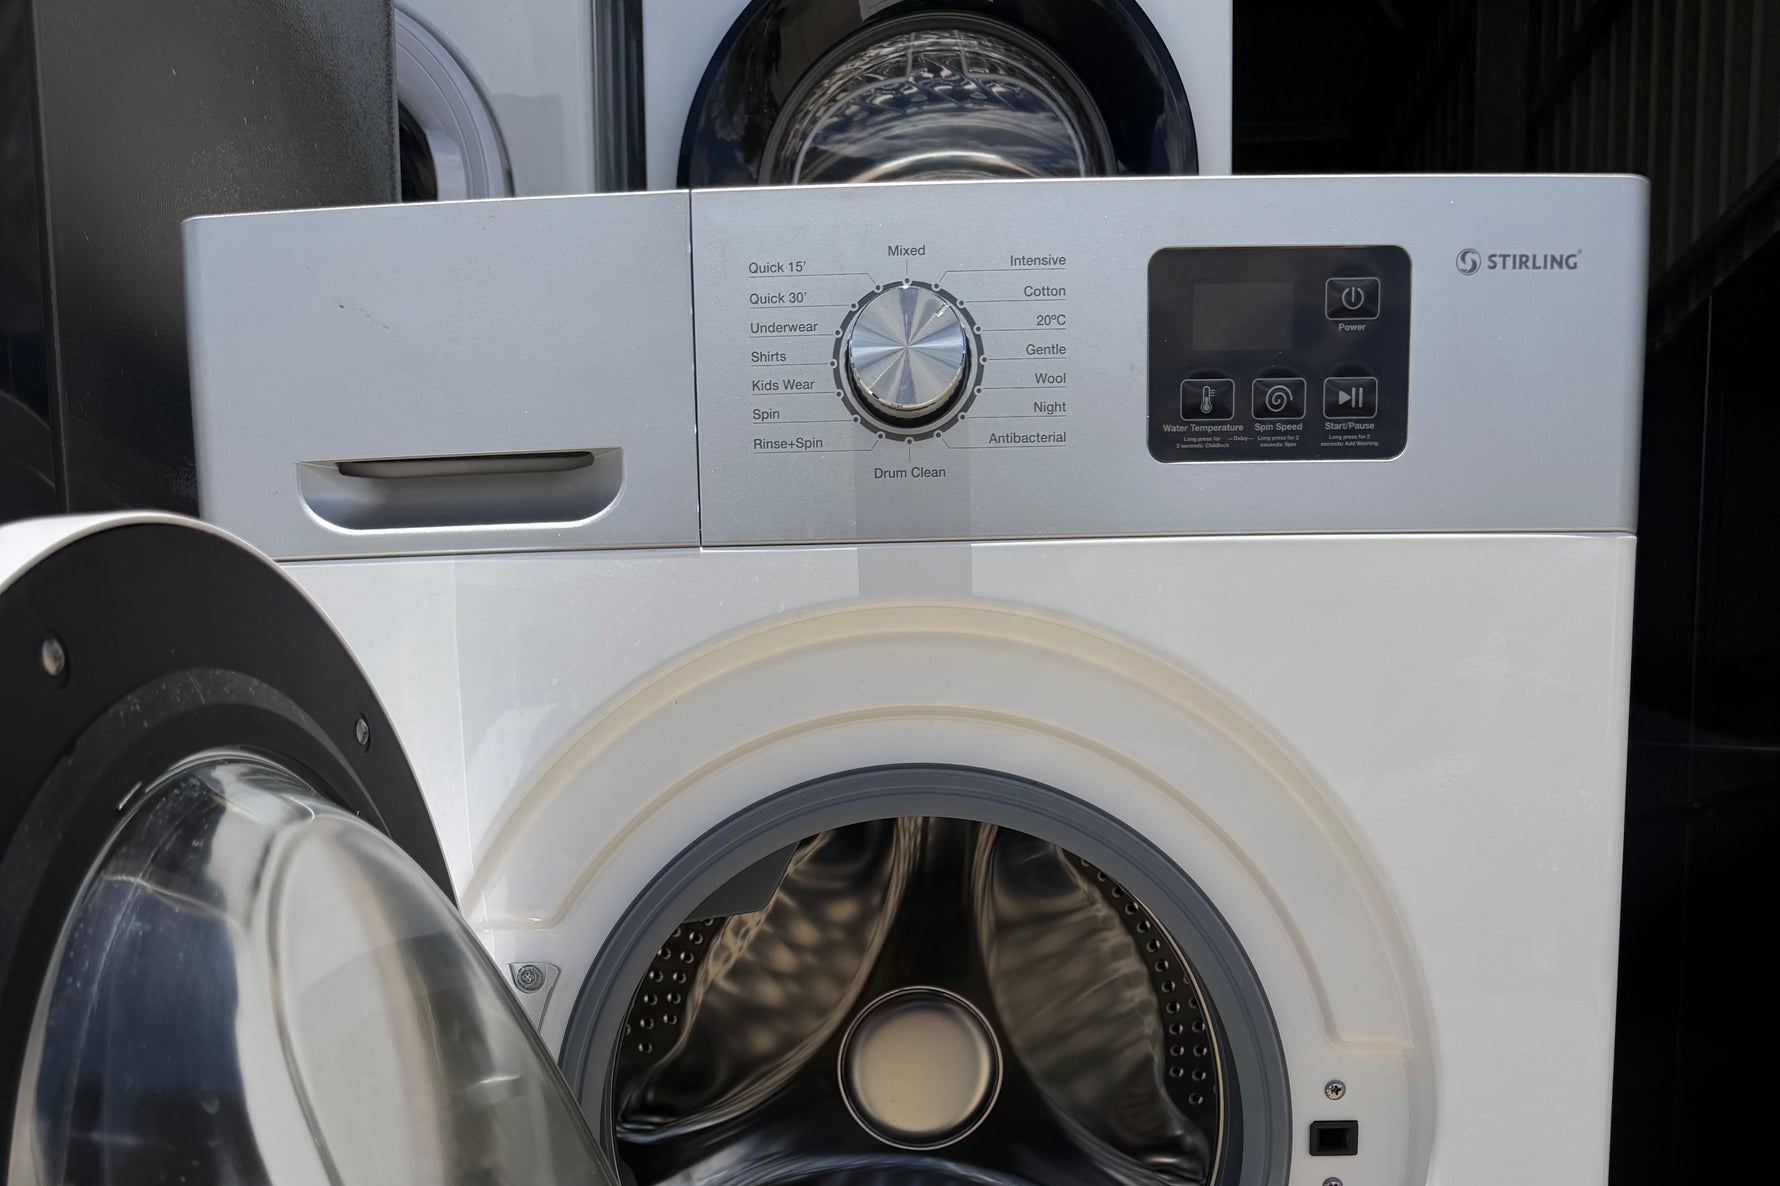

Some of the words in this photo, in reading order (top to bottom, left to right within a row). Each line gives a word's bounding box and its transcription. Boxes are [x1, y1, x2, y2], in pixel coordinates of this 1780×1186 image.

[888, 246, 925, 256] Mixed
[1010, 255, 1066, 266] Intensive
[1487, 253, 1578, 270] STIRLING
[749, 263, 784, 274] Quick
[788, 261, 807, 273] 15'
[1024, 286, 1066, 297] Cotton
[750, 293, 785, 305] Quick
[789, 292, 807, 303] 30'
[751, 322, 818, 333] Underwear
[1026, 344, 1066, 355] Gentle
[751, 352, 786, 362] Shirts
[1035, 373, 1066, 384] Wool
[752, 380, 779, 391] Kids
[782, 380, 815, 390] Wear
[1034, 402, 1066, 414] Night
[753, 409, 780, 421] Spin
[1163, 424, 1188, 432] Water
[1190, 424, 1244, 432] Temperature
[1254, 423, 1273, 432] Spin
[1275, 422, 1302, 432] Speed
[1325, 422, 1374, 430] Start/Pause
[989, 432, 1066, 444] Antibacterial
[754, 438, 822, 450] Rinse+Spin
[874, 468, 908, 478] Drum
[912, 467, 946, 478] Clean
